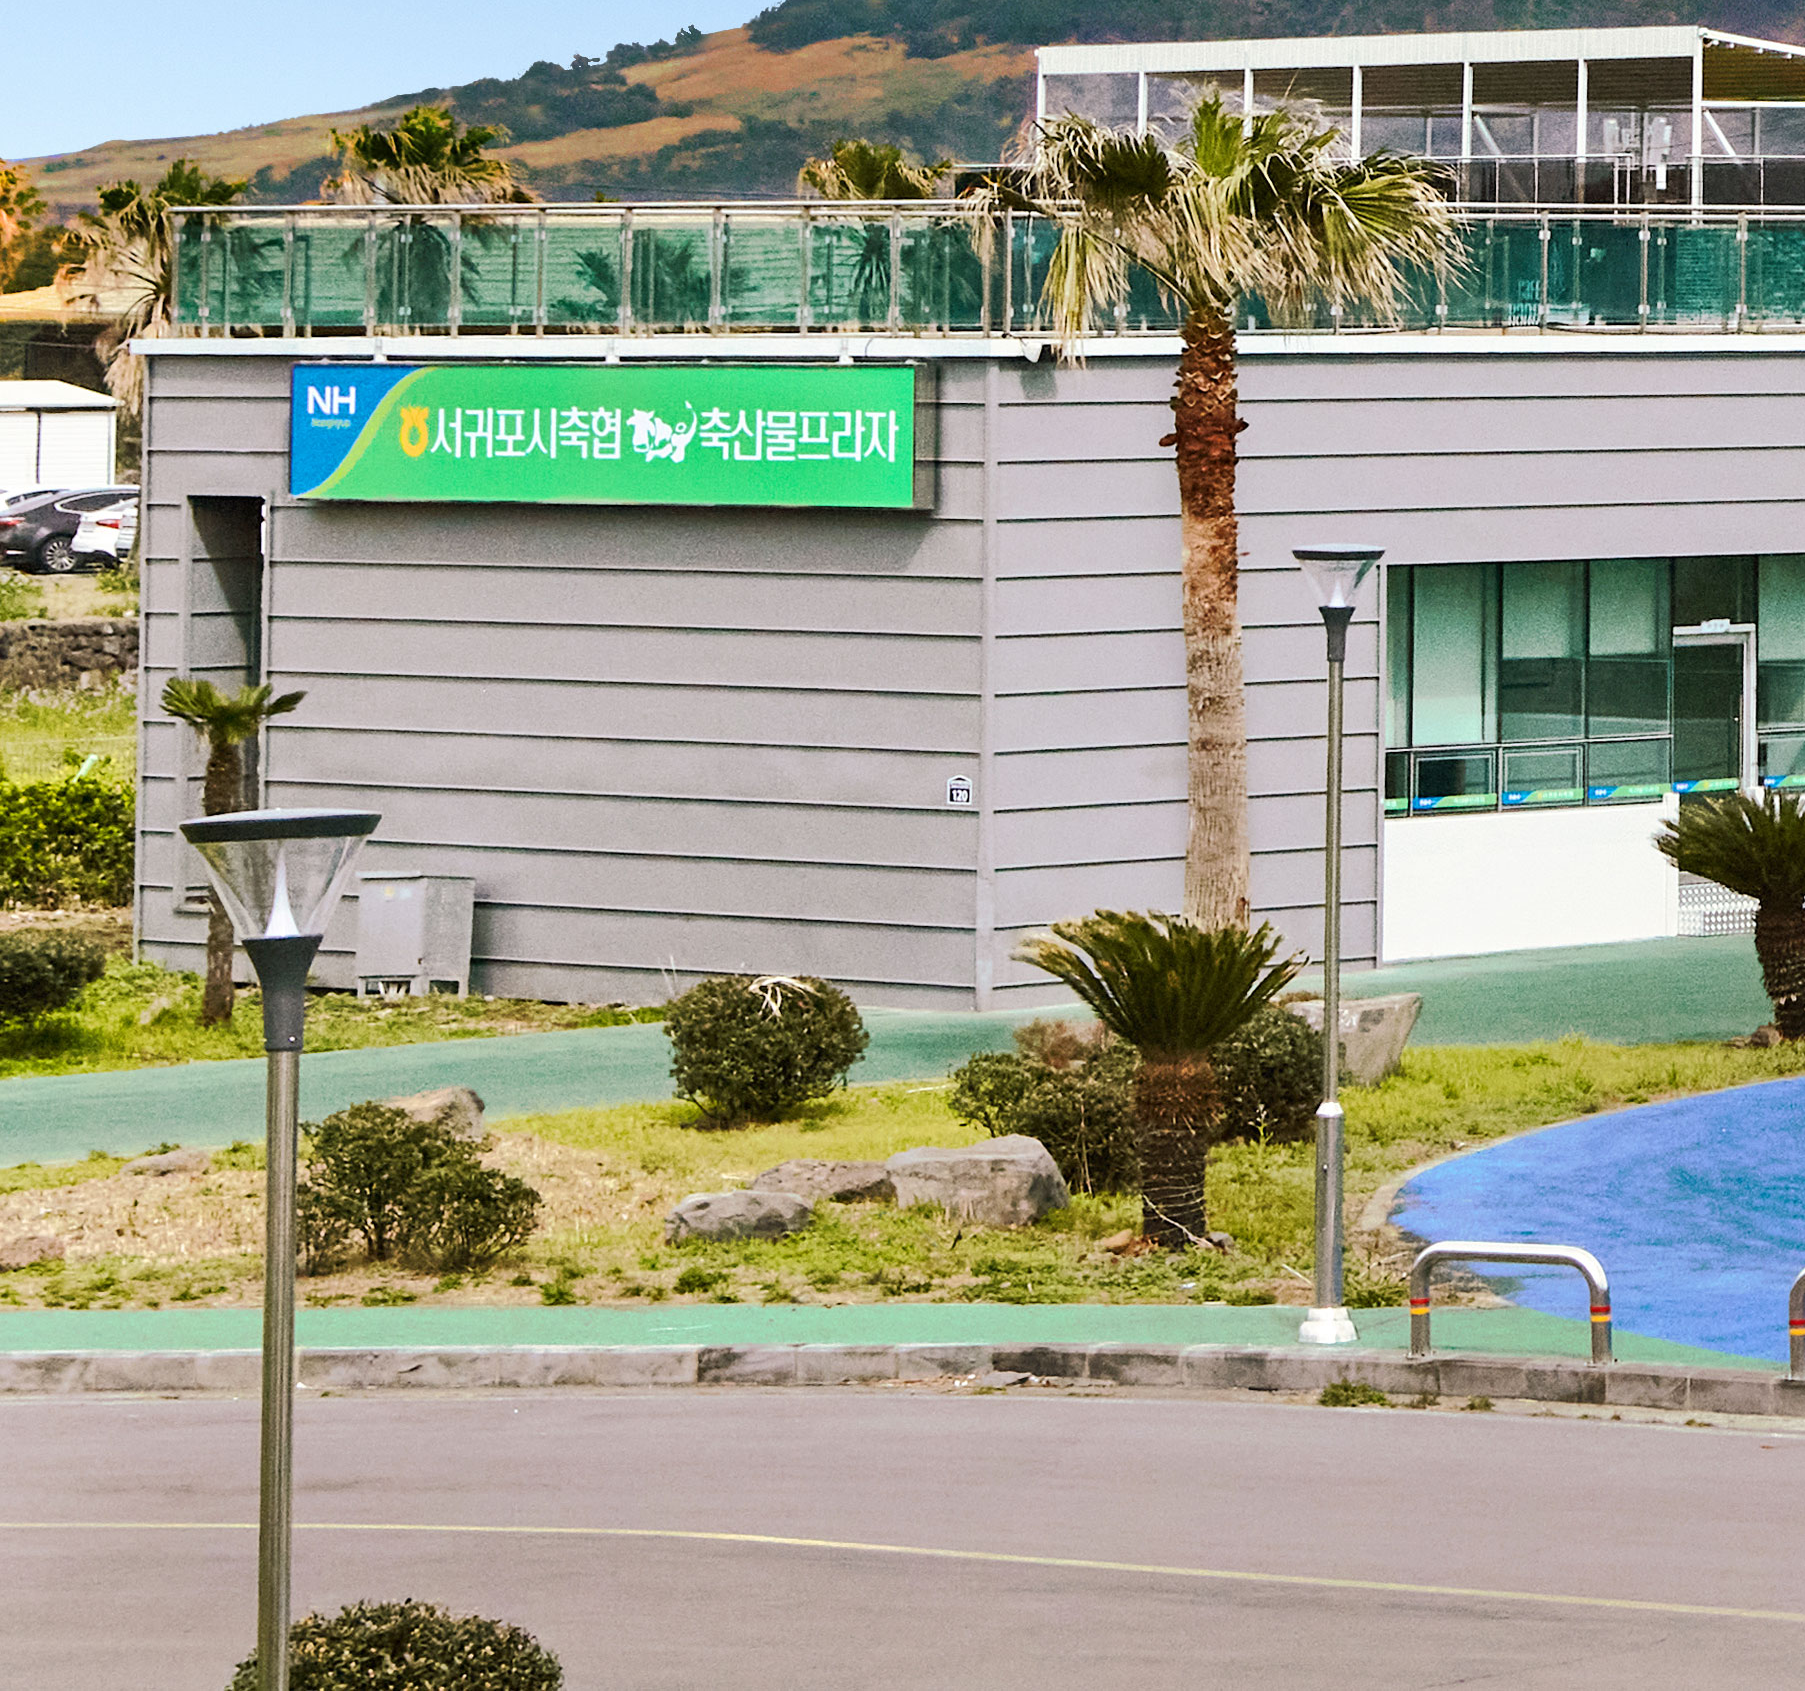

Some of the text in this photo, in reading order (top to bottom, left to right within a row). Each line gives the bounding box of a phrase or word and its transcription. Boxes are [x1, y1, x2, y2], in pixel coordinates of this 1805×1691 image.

[307, 385, 356, 415] NH
[430, 406, 899, 462] 서귀포시축협 축산물프라자
[951, 789, 969, 802] 120
